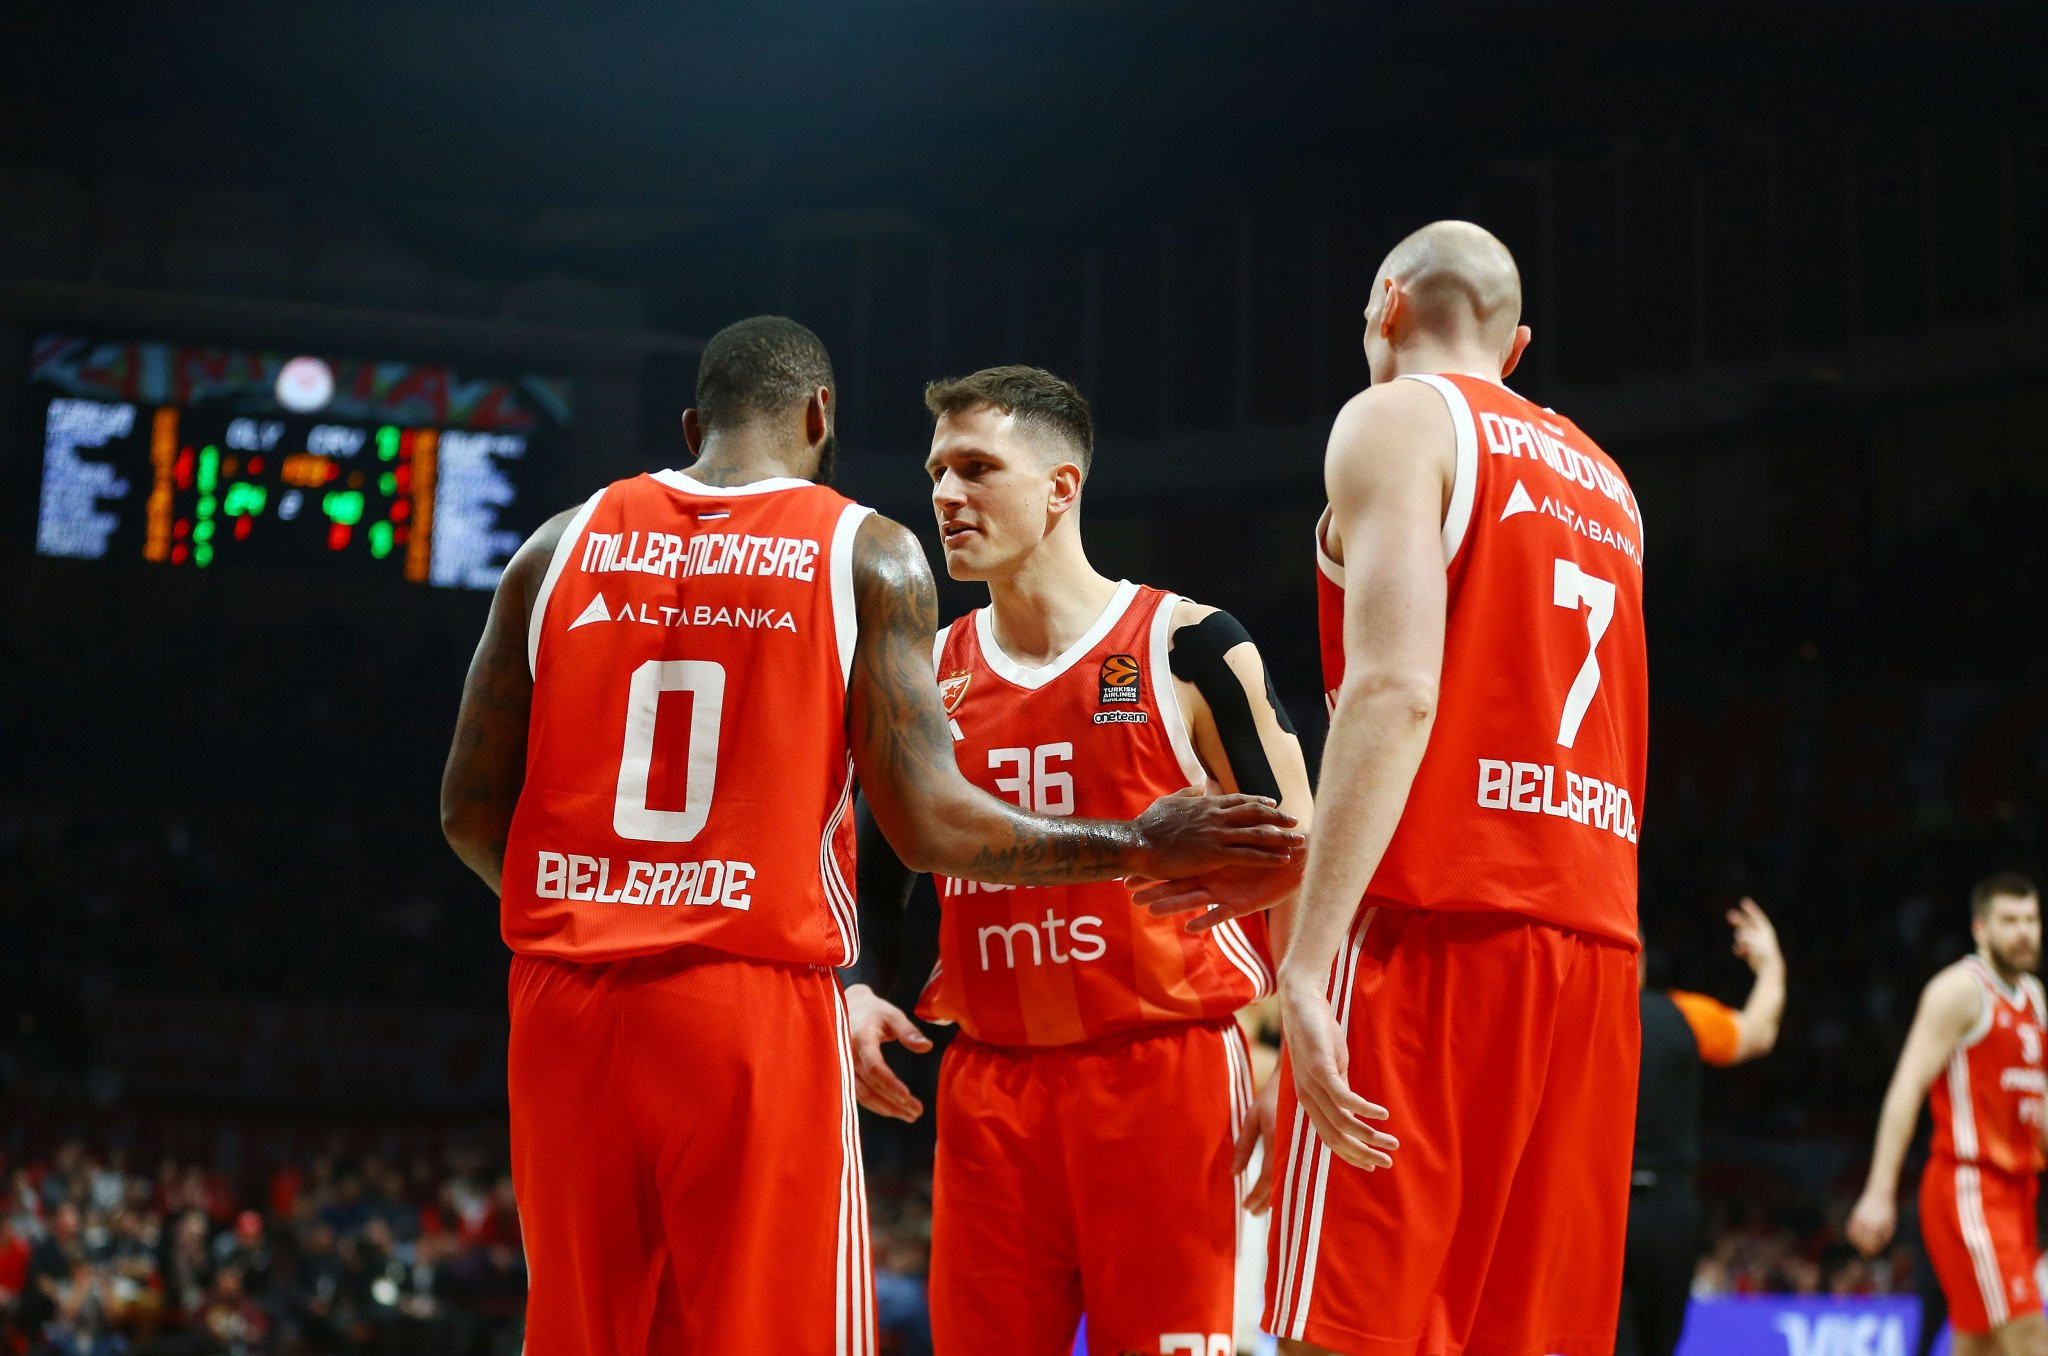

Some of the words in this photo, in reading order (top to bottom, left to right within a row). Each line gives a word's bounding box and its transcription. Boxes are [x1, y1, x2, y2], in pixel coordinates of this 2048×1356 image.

[1479, 411, 1636, 525] DAVIDOVAC
[580, 531, 820, 583] MILLER-MCINTYRE
[1540, 495, 1644, 574] ALTABANKA
[616, 602, 798, 634] ALTABANKA
[1553, 557, 1616, 750] 7
[612, 659, 726, 843] 0
[1094, 710, 1148, 724] oneteam
[987, 741, 1075, 817] 36
[536, 850, 756, 912] BELGRADE
[977, 908, 1107, 971] mts
